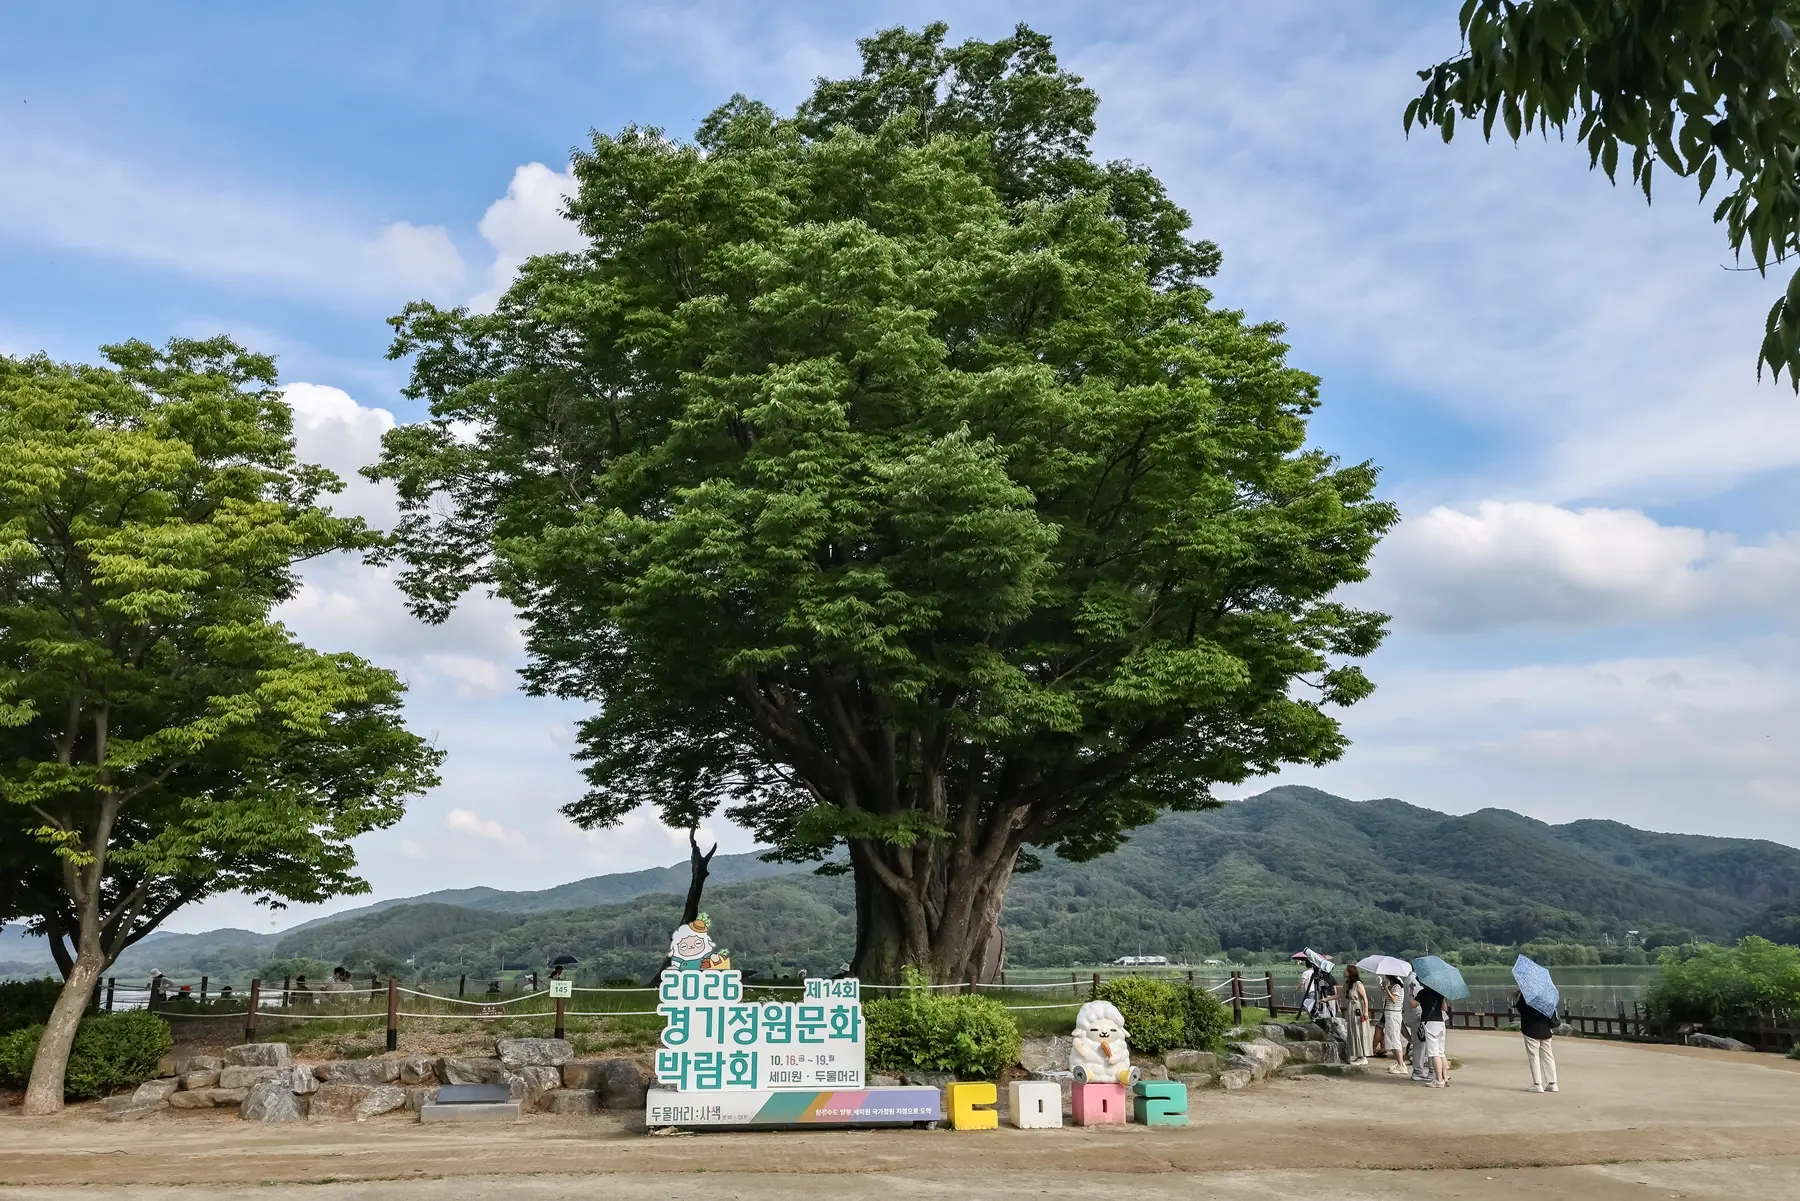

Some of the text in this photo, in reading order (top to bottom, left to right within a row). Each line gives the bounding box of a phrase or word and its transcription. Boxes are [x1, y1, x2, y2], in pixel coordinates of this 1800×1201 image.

[663, 974, 739, 1000] 2026
[806, 981, 857, 999] 제14회
[660, 1005, 861, 1045] 경기정원문화
[658, 1050, 758, 1090] 박람회
[770, 1055, 783, 1066] 10.
[769, 1070, 802, 1083] 세미원
[815, 1070, 859, 1083] 두물머리
